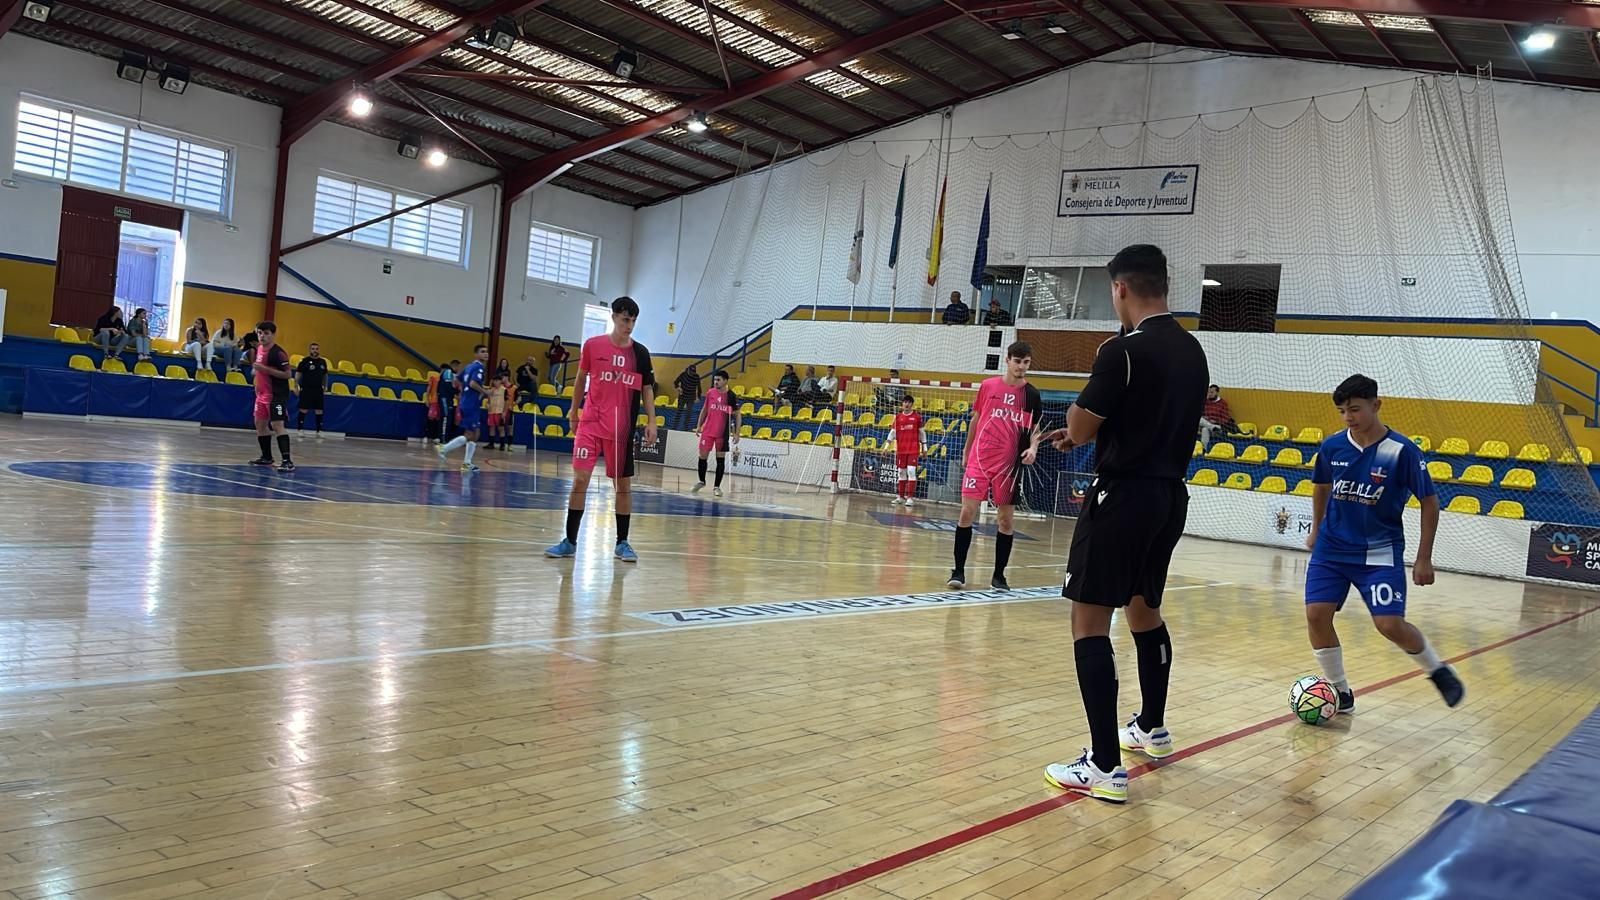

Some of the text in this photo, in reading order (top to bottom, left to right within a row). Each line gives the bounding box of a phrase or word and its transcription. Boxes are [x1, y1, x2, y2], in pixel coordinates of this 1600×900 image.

[1084, 181, 1121, 190] MELILLA
[1104, 197, 1113, 207] de
[1115, 195, 1146, 209] Deporte
[1147, 197, 1152, 209] y
[1153, 194, 1188, 208] Juventud
[612, 354, 625, 367] 10
[1003, 392, 1016, 405] 12
[576, 447, 589, 459] 10
[743, 457, 778, 469] MELILLA
[965, 477, 977, 489] 12
[1332, 479, 1385, 500] MELILLA
[1370, 583, 1393, 606] 10
